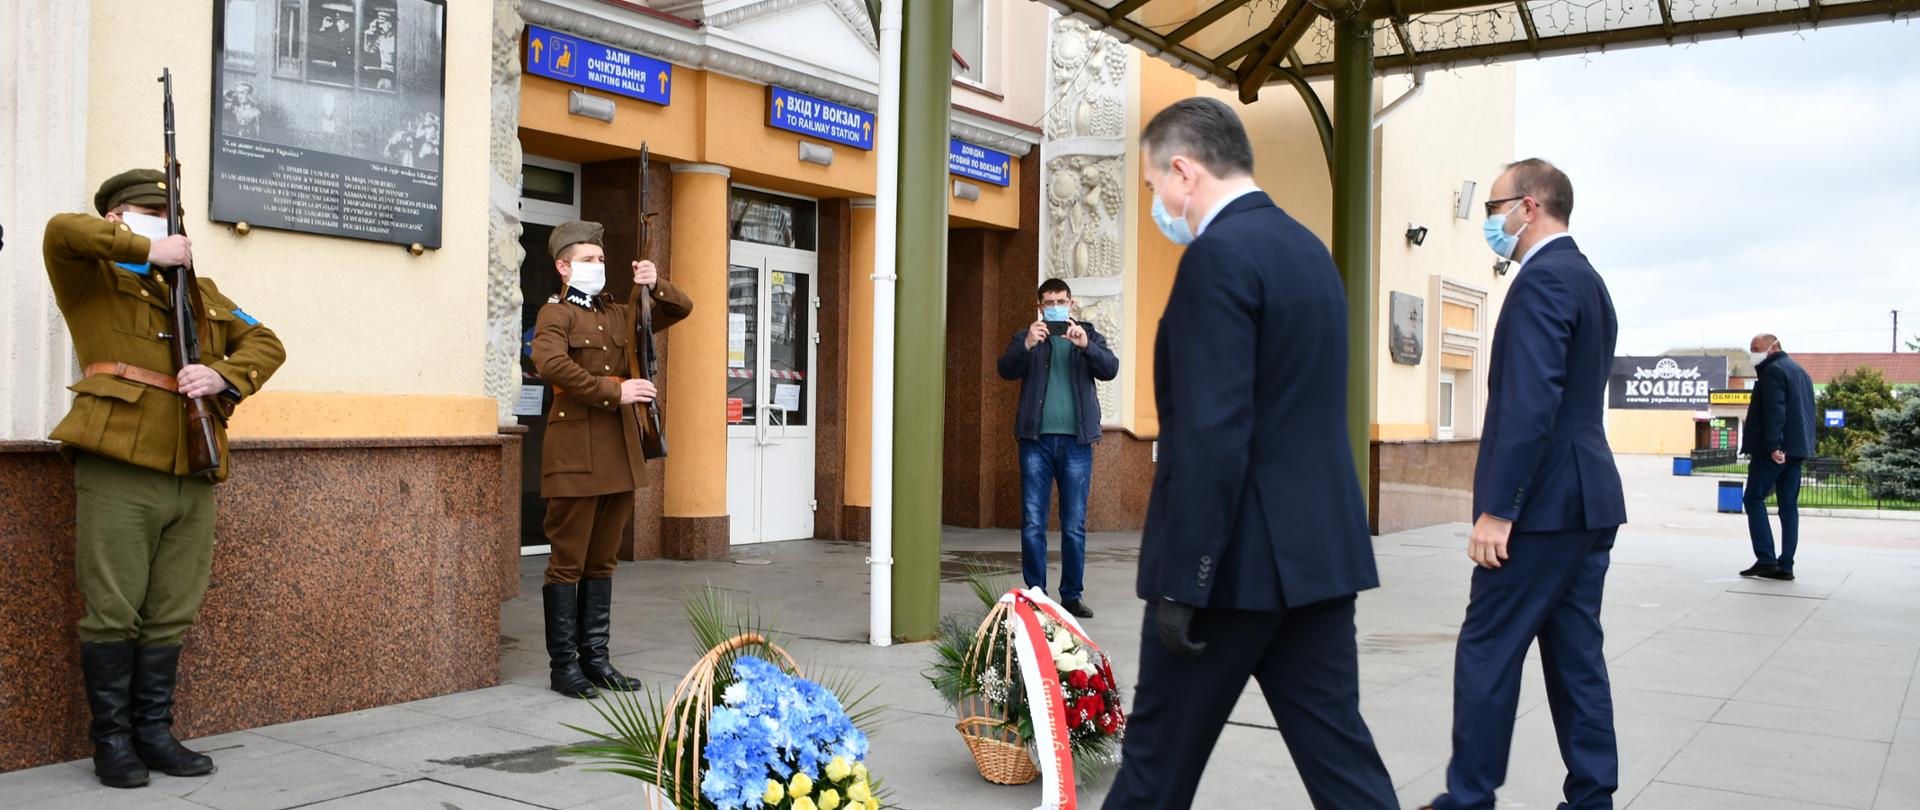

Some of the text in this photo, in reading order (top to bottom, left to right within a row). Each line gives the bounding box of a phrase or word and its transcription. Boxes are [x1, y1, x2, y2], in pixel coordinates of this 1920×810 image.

[606, 49, 630, 65] ЗАЛИ
[588, 58, 646, 82] ОЧІКУВАННЯ
[588, 71, 645, 93] WAITING HALLS
[787, 96, 860, 128] ВХІД У ВОКЗАЛ
[787, 114, 860, 142] TO RAILWAY STATION
[962, 145, 984, 159] ДОВІДКА
[971, 160, 978, 168] ПО
[980, 162, 1001, 174] ВОКЗАЛУ
[1626, 380, 1708, 396] КОЛИБА
